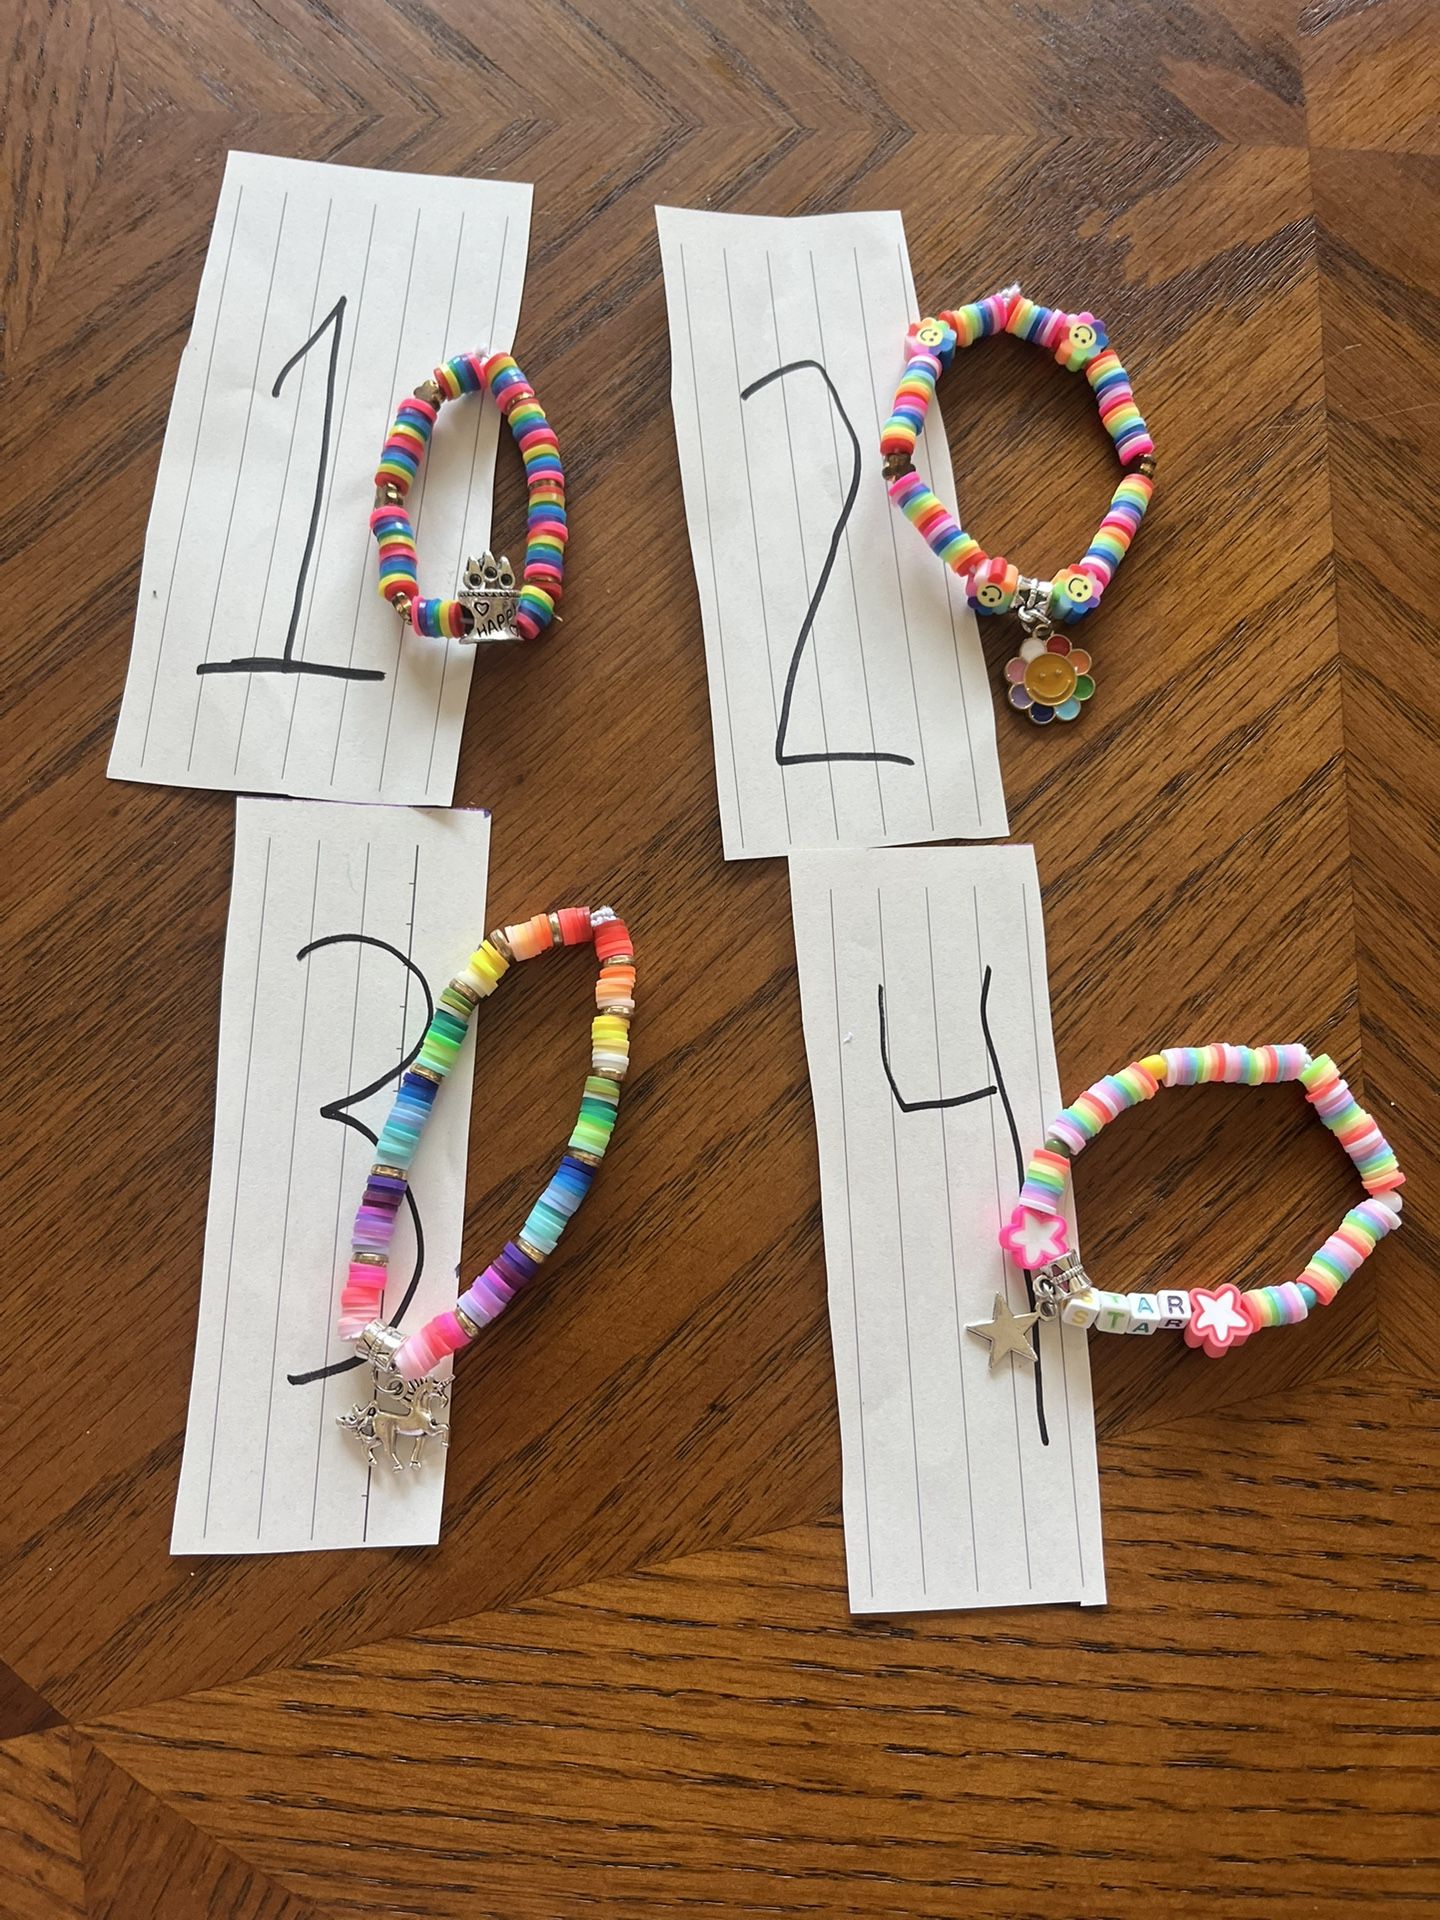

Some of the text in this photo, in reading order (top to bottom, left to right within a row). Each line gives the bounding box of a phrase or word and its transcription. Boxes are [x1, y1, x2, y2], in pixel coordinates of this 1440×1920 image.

[196, 295, 387, 681] 1
[741, 360, 915, 767] 2
[287, 934, 434, 1386] 3
[879, 965, 1050, 1447] 4
